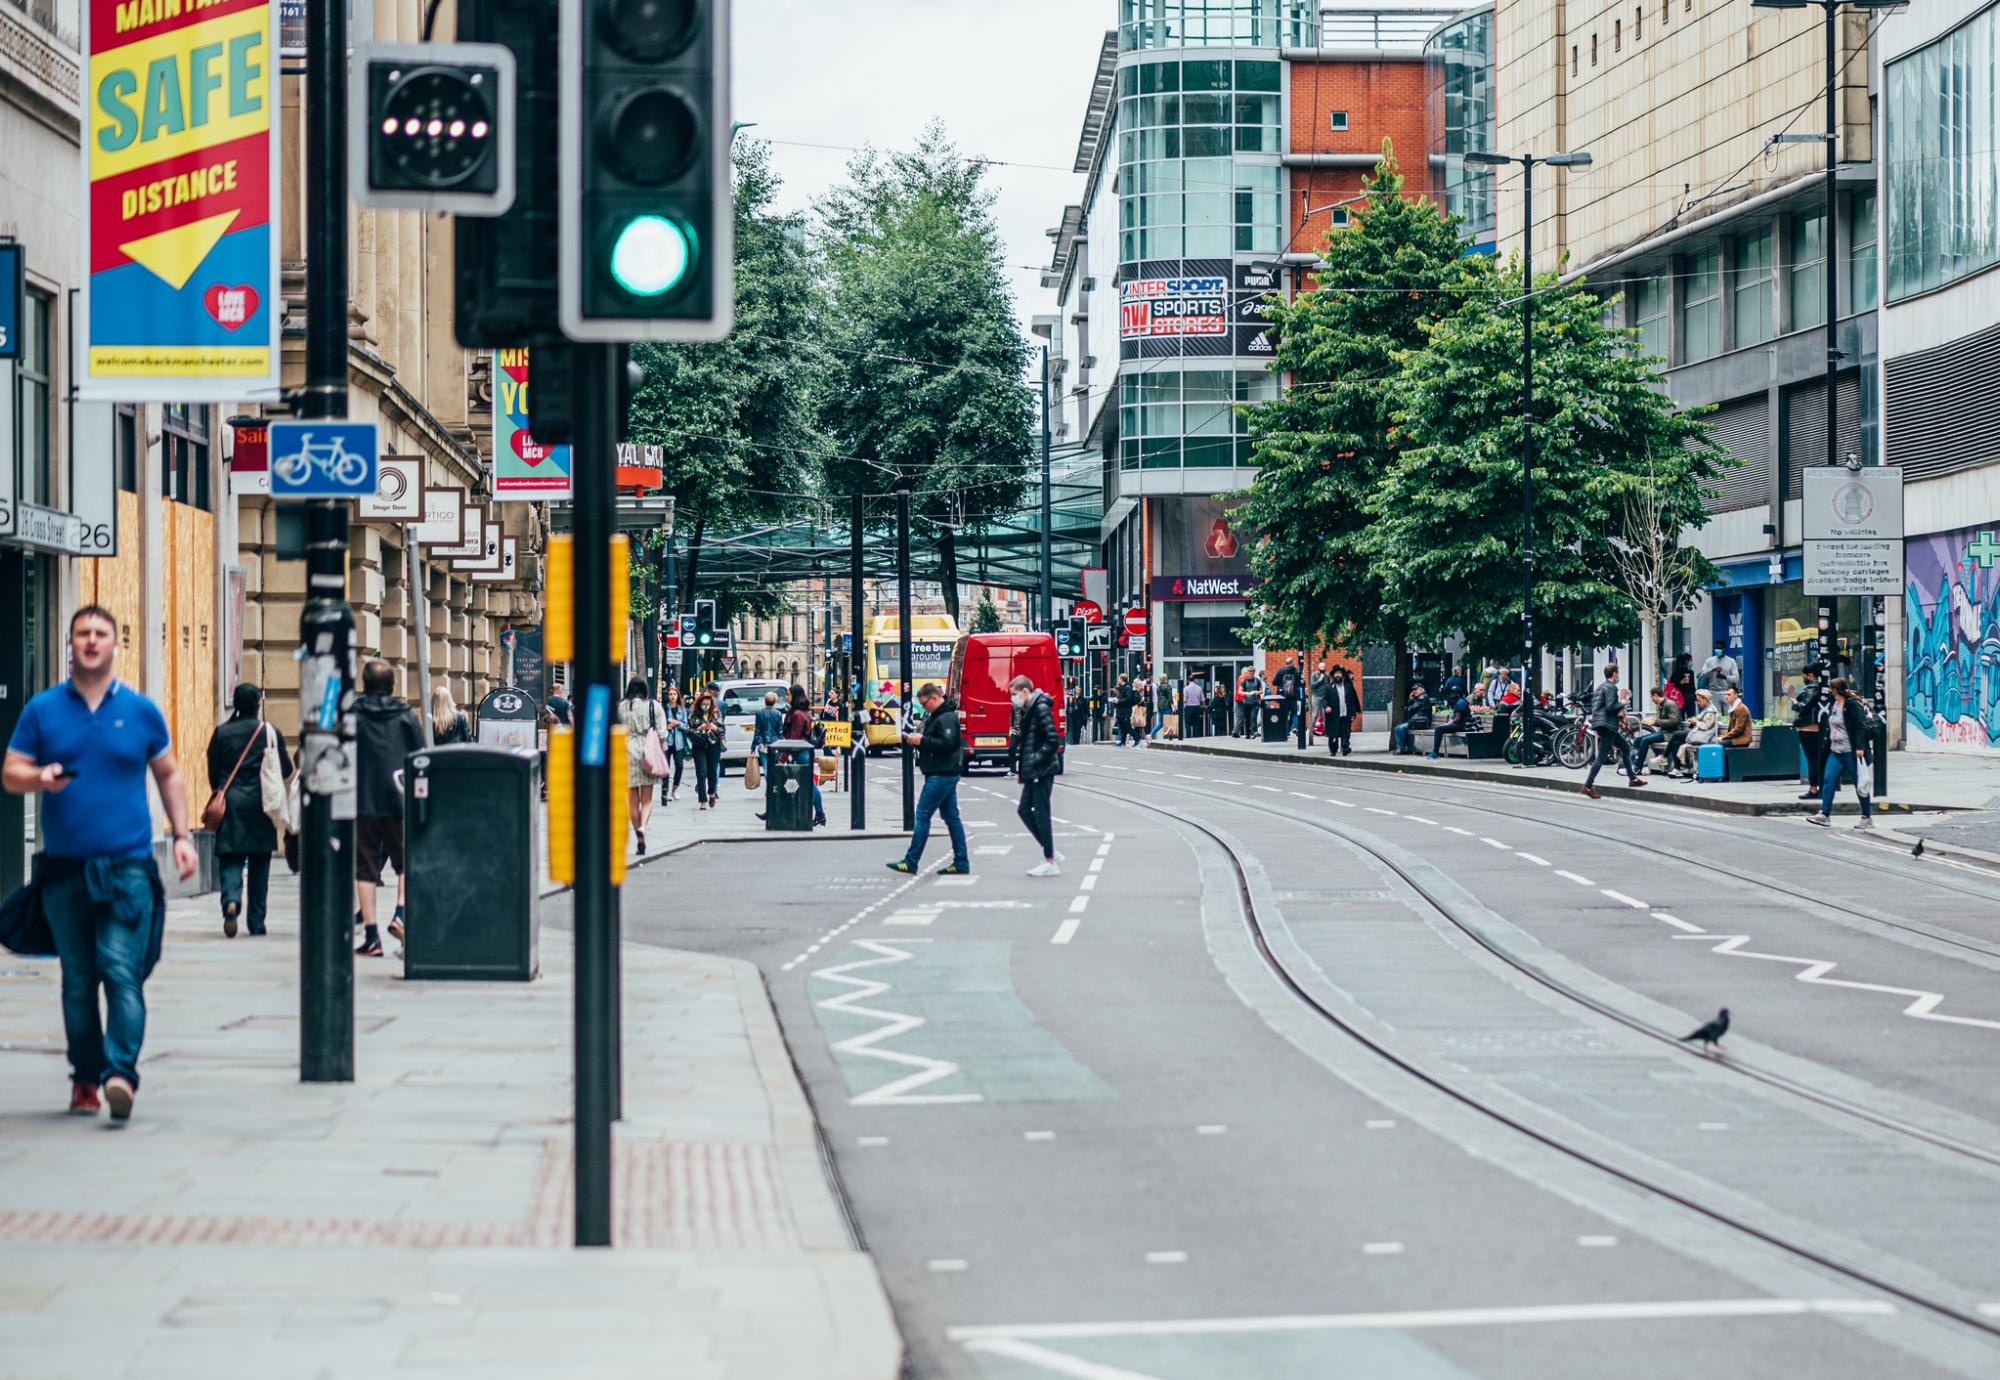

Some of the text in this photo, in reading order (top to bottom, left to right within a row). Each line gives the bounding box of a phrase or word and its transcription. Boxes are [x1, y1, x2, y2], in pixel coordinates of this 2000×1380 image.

[97, 31, 262, 152] SAFE
[121, 159, 238, 221] DISTANCE
[1129, 279, 1223, 297] INTERSPORT
[1244, 276, 1270, 286] PUMA
[217, 290, 246, 306] LOVE
[217, 306, 245, 322] MCR
[1153, 300, 1221, 316] SPORTS
[1121, 303, 1148, 335] DW
[1154, 316, 1221, 333] STORES
[95, 354, 264, 366] welcomebackmanchester.com
[522, 447, 544, 459] MCR
[372, 504, 390, 512] Stage
[80, 523, 111, 549] 26
[1830, 528, 1842, 536] No
[1852, 568, 1890, 576] carriages
[1187, 578, 1239, 595] NatWest
[1843, 577, 1867, 585] badge
[911, 643, 951, 652] free bus
[911, 652, 941, 661] around
[911, 661, 943, 672] the city
